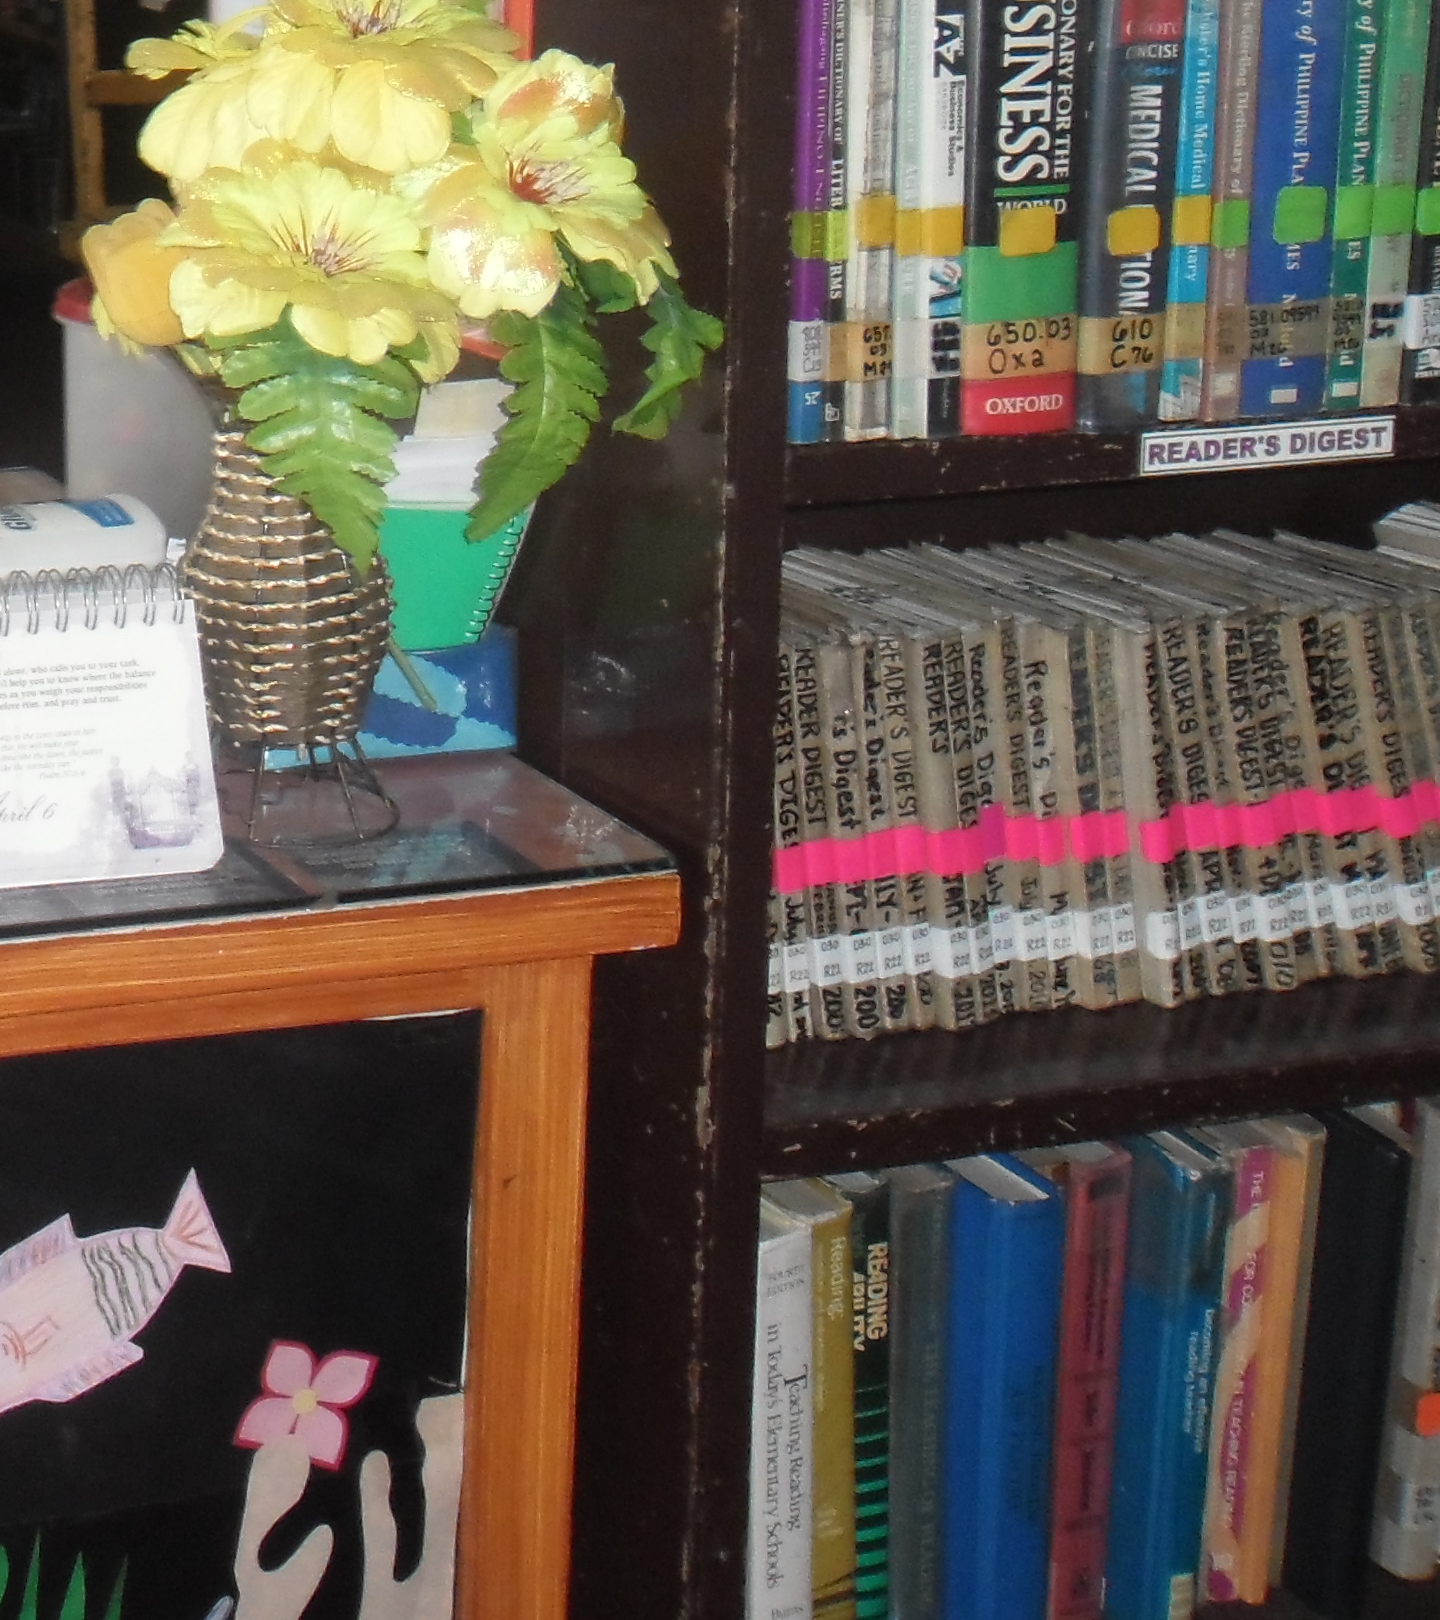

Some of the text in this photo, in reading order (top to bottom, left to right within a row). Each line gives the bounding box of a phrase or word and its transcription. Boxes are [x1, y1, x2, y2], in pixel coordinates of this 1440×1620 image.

[1055, 84, 1075, 123] FOR
[1053, 129, 1072, 180] THE
[1124, 84, 1164, 196] MEDICAL
[1190, 123, 1208, 190] Medical
[1290, 150, 1311, 186] PLA
[1350, 141, 1370, 186] PLAN
[830, 159, 844, 210] LITER
[986, 316, 1071, 347] 650.03
[1111, 318, 1153, 343] 610
[986, 394, 1064, 415] OXFORD
[1148, 427, 1388, 467] READER'S DIGEST
[801, 747, 827, 825] DIGEST
[832, 750, 861, 830] Digest
[891, 750, 917, 818] DIGEST
[957, 764, 979, 830] DIGES
[1182, 743, 1211, 805] DIGES
[42, 802, 59, 820] 6
[866, 1241, 888, 1341] READING
[783, 1363, 807, 1533] Teaching Reading
[765, 1522, 782, 1590] Schools
